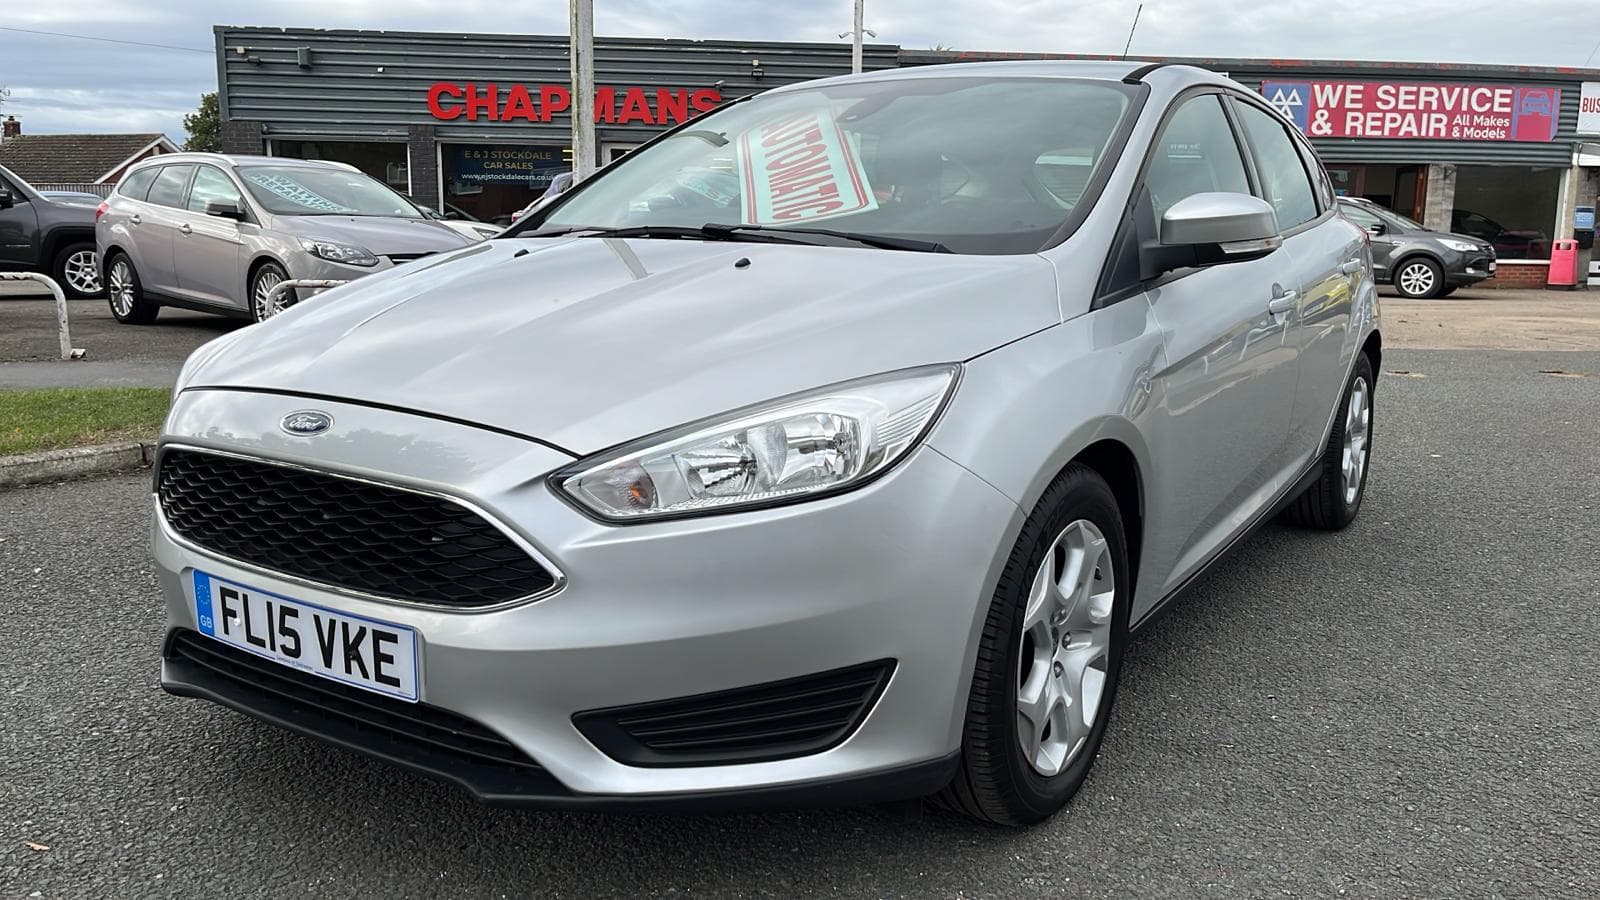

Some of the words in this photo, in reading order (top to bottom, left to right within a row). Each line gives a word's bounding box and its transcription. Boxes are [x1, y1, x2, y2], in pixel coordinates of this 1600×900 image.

[1312, 85, 1364, 109] WE
[1375, 85, 1513, 113] SERVICE
[1311, 109, 1333, 136] &
[1344, 112, 1448, 137] REPAIR
[1452, 115, 1470, 127] All
[1472, 115, 1510, 128] Makes
[1451, 127, 1461, 139] &
[1463, 127, 1506, 139] Models
[464, 150, 472, 159] E
[473, 150, 481, 159] &
[482, 150, 489, 159] J
[491, 150, 552, 160] STOCKDALE
[483, 161, 503, 169] CAR
[504, 161, 534, 170] SALES
[761, 111, 844, 220] AUTOMATIC
[200, 615, 212, 628] GB
[219, 586, 301, 659] FL15
[313, 614, 401, 687] VKE
